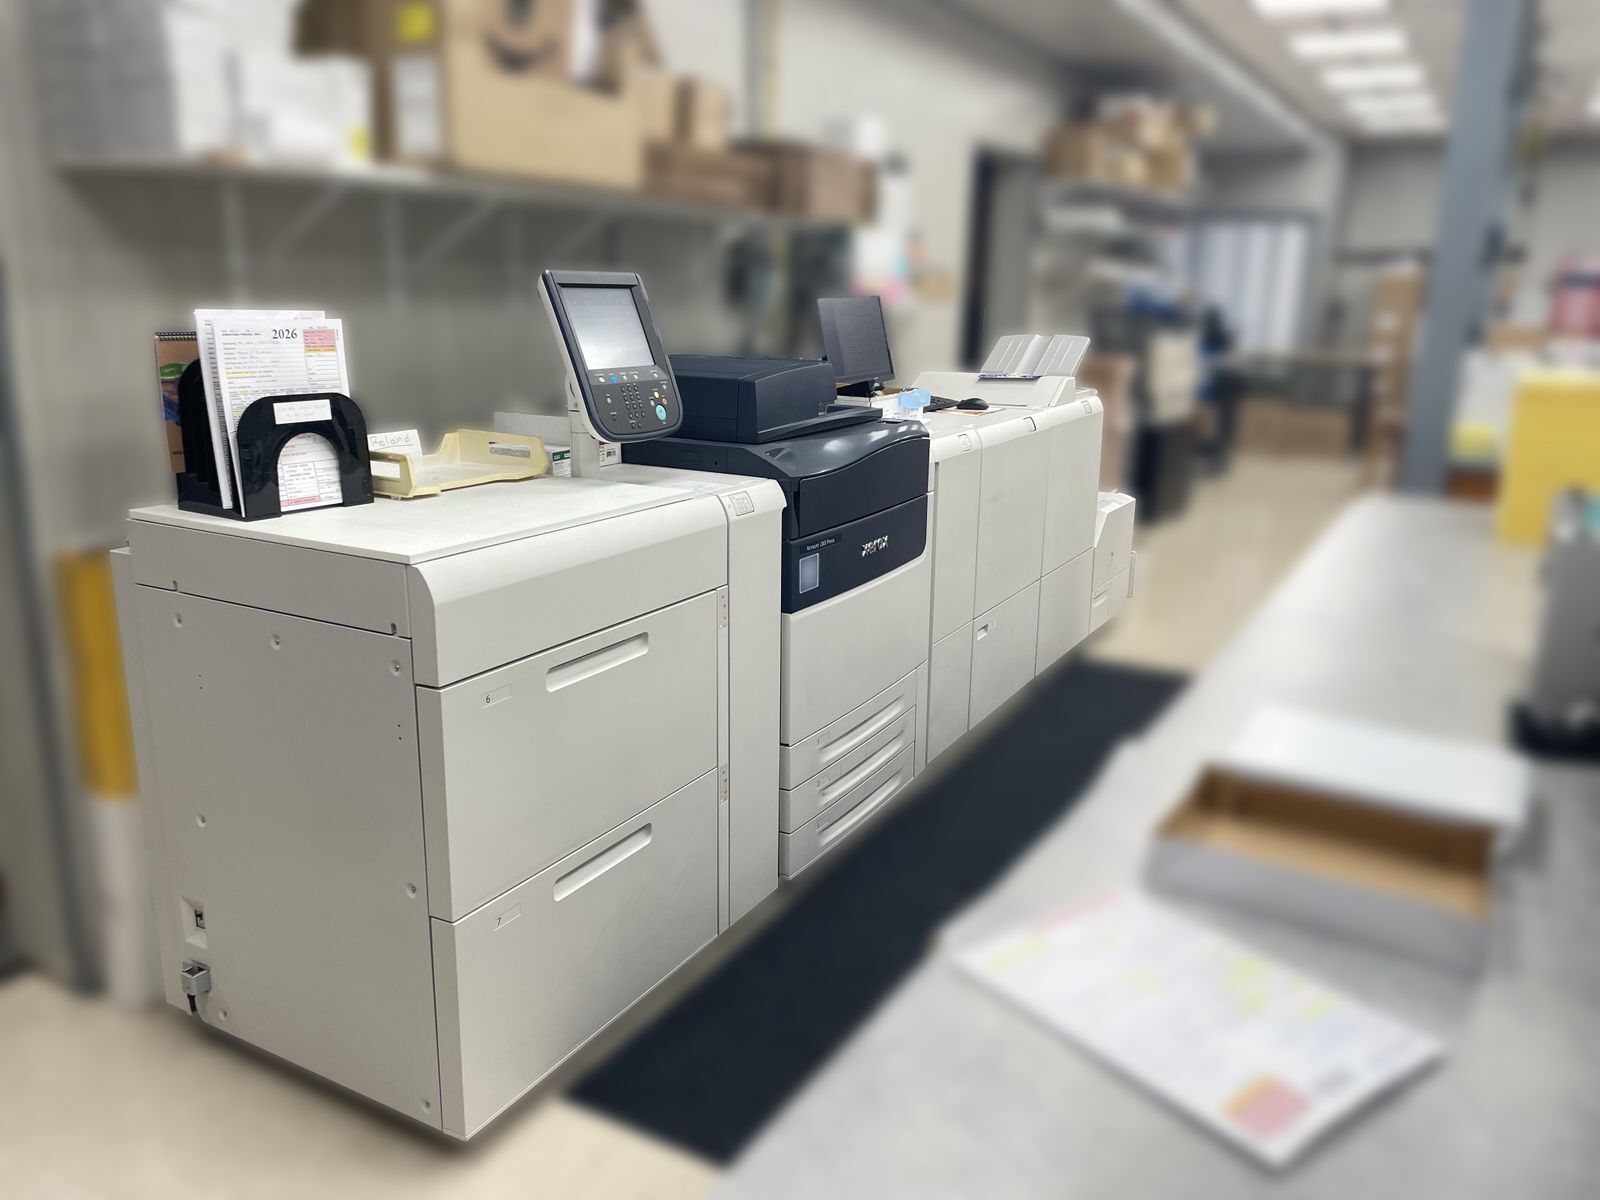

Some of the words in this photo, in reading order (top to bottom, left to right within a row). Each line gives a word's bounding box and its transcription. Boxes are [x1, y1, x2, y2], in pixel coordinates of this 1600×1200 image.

[272, 328, 298, 340] 2026
[370, 433, 410, 449] Roland
[861, 535, 889, 557] xerox
[486, 694, 491, 704] 6
[497, 916, 502, 926] 7
